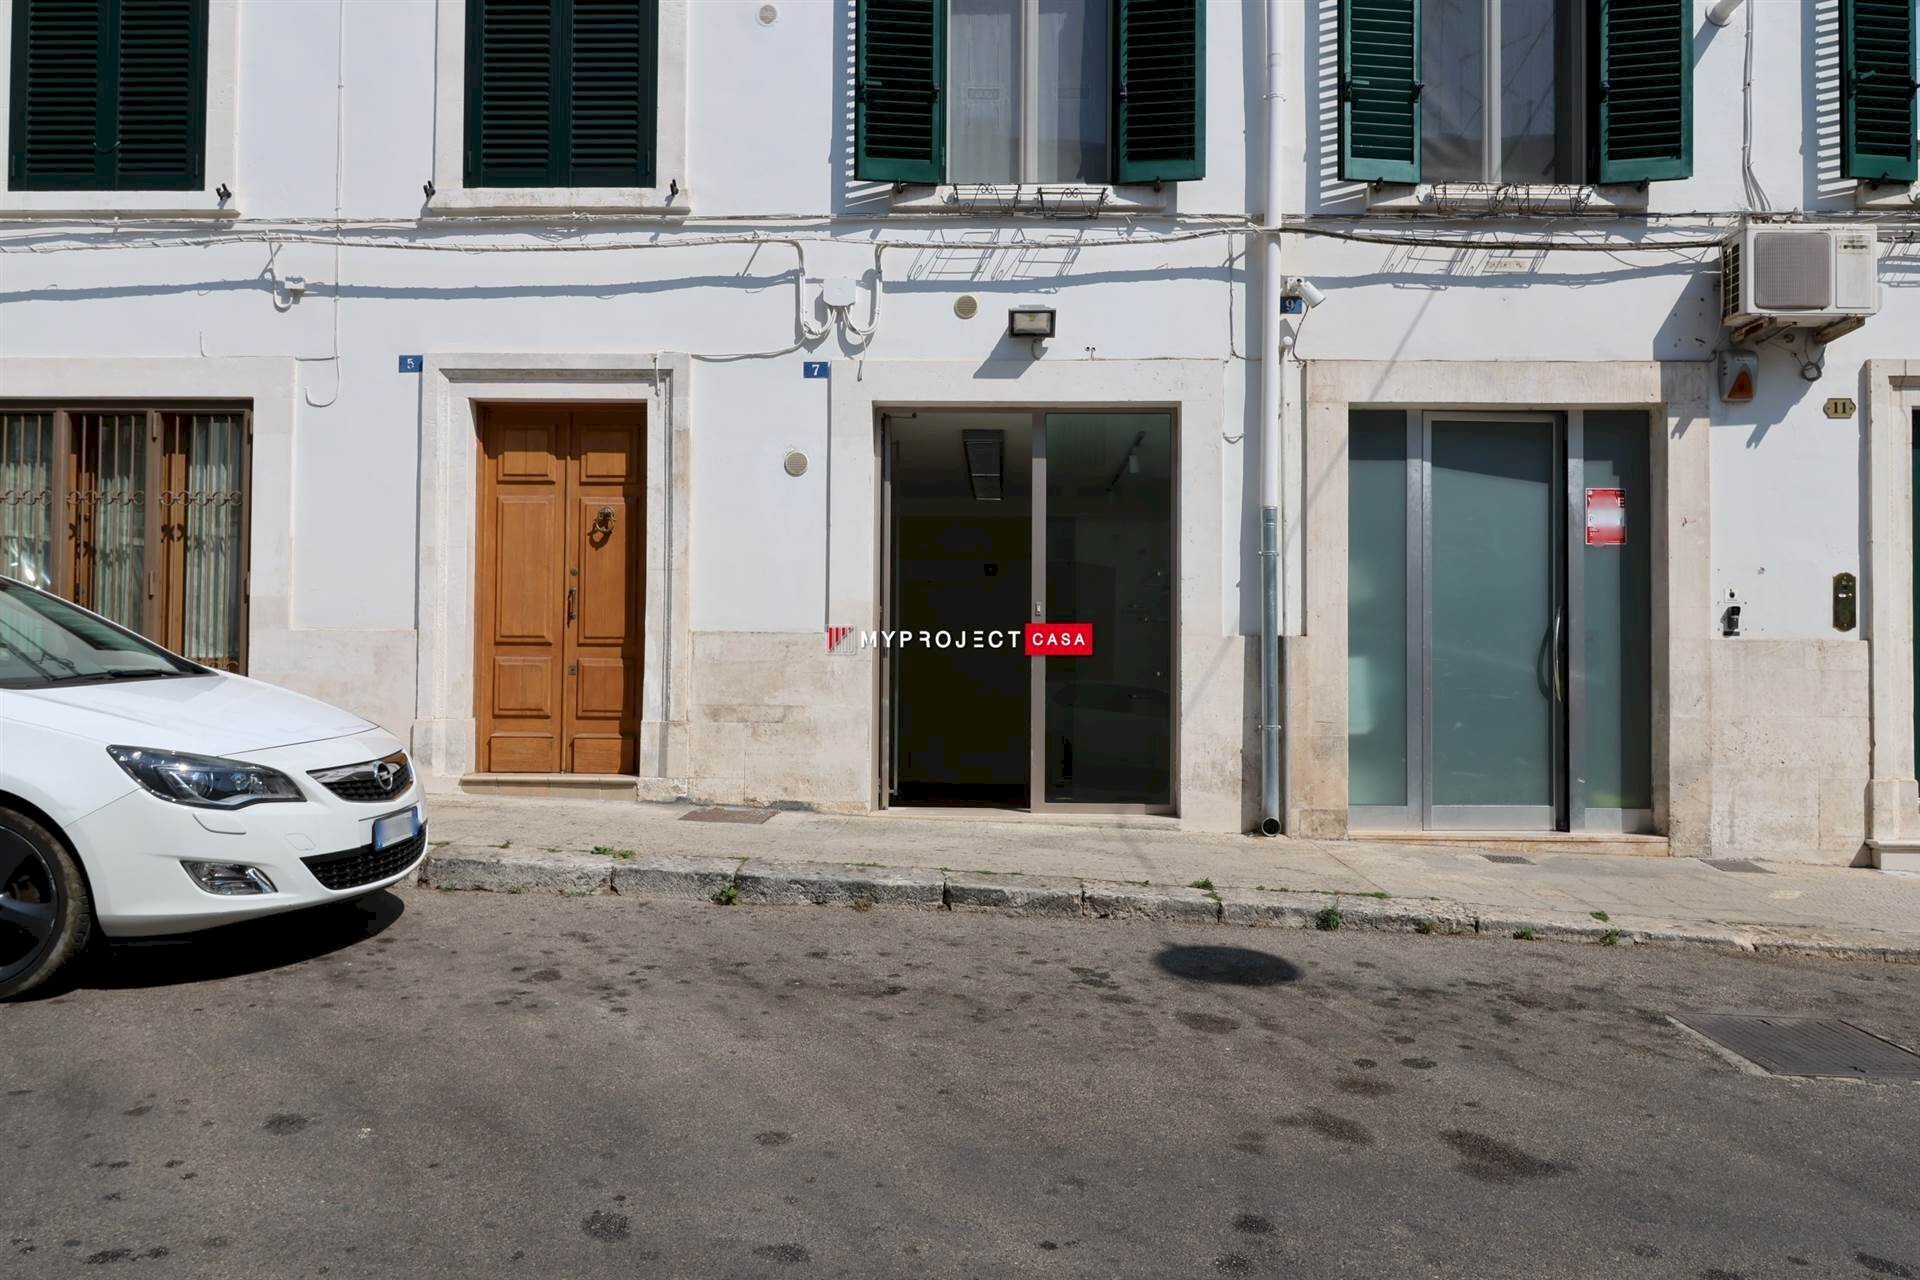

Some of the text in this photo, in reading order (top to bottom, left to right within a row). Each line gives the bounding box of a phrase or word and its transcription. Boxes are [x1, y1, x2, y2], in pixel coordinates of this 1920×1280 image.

[1286, 299, 1295, 311] 9
[407, 358, 415, 369] 5
[811, 364, 820, 376] 7
[1833, 401, 1847, 414] 11
